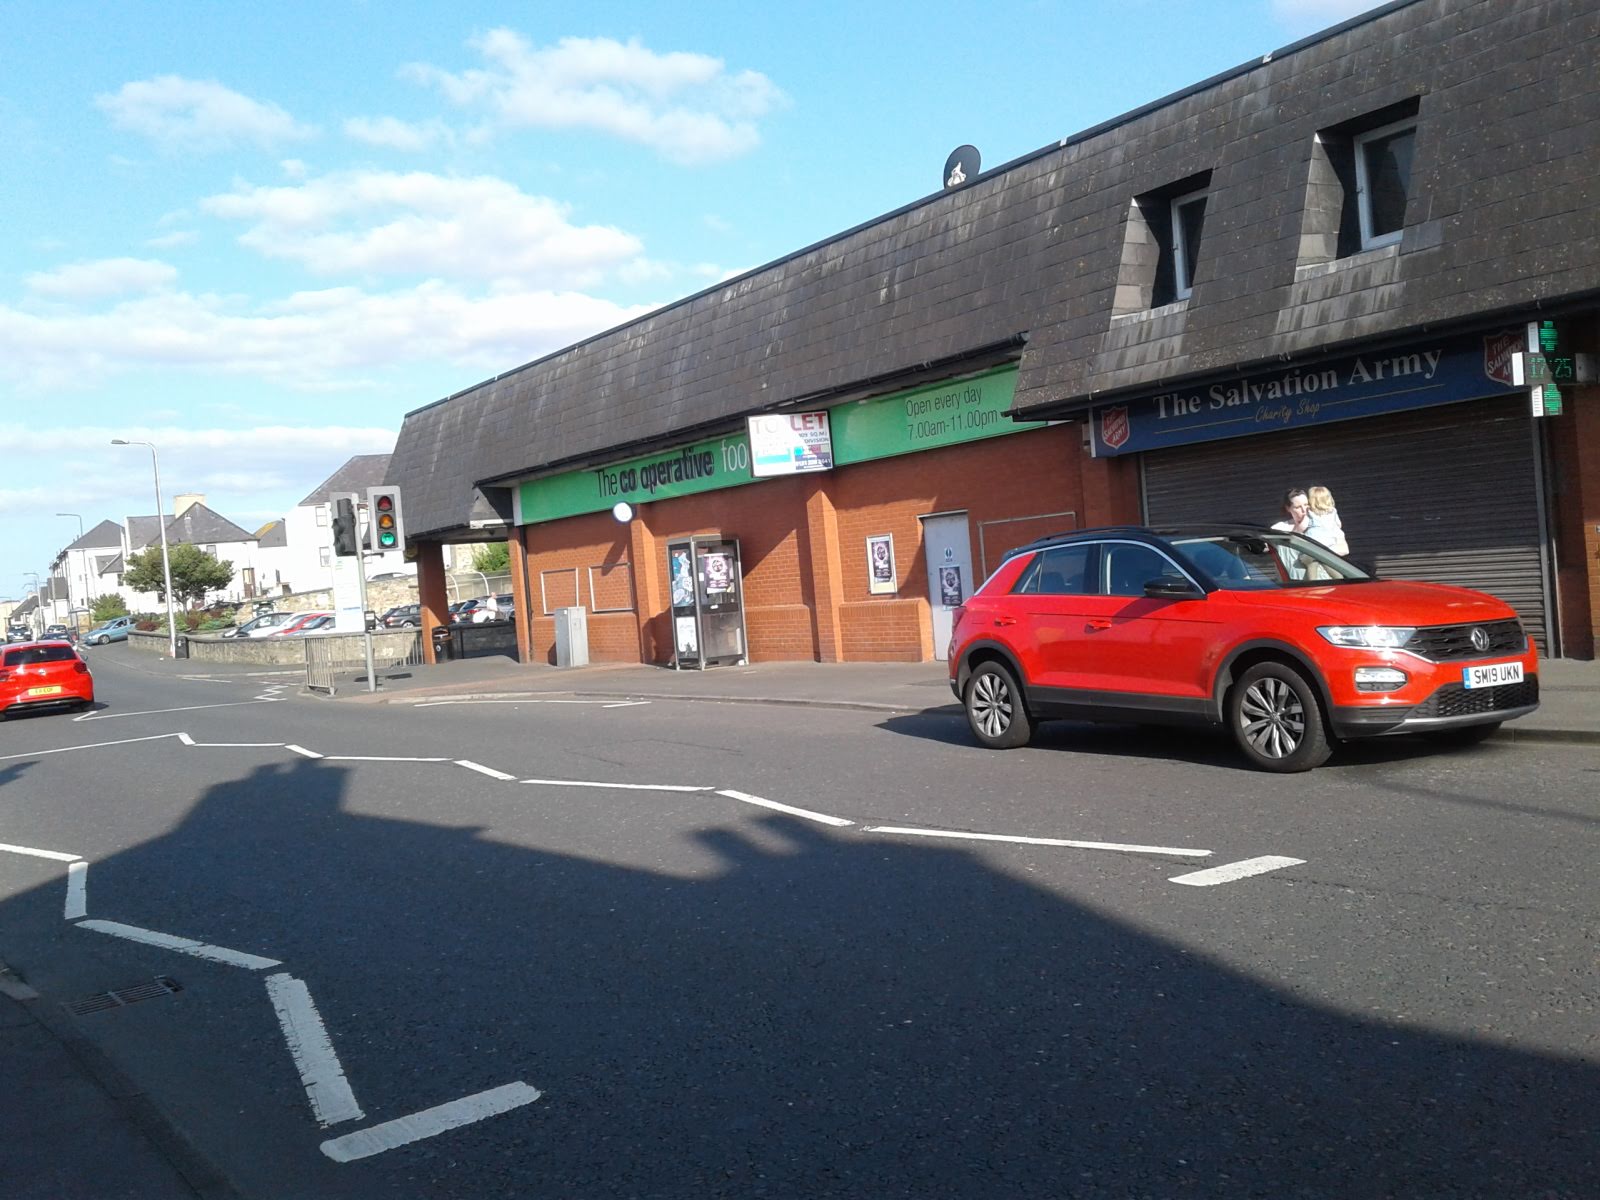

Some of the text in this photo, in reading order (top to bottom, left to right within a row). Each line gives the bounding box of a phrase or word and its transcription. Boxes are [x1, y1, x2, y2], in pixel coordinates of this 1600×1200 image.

[1529, 358, 1572, 379] 17:25
[1153, 350, 1442, 419] The Salvation Army
[906, 386, 982, 418] Open every day
[1255, 399, 1320, 423] Charity Shop
[790, 413, 827, 431] LET
[907, 409, 998, 440] 7.00am-11.00pm
[596, 439, 750, 497] The co operative foo
[1474, 665, 1520, 684] SM19 UKN
